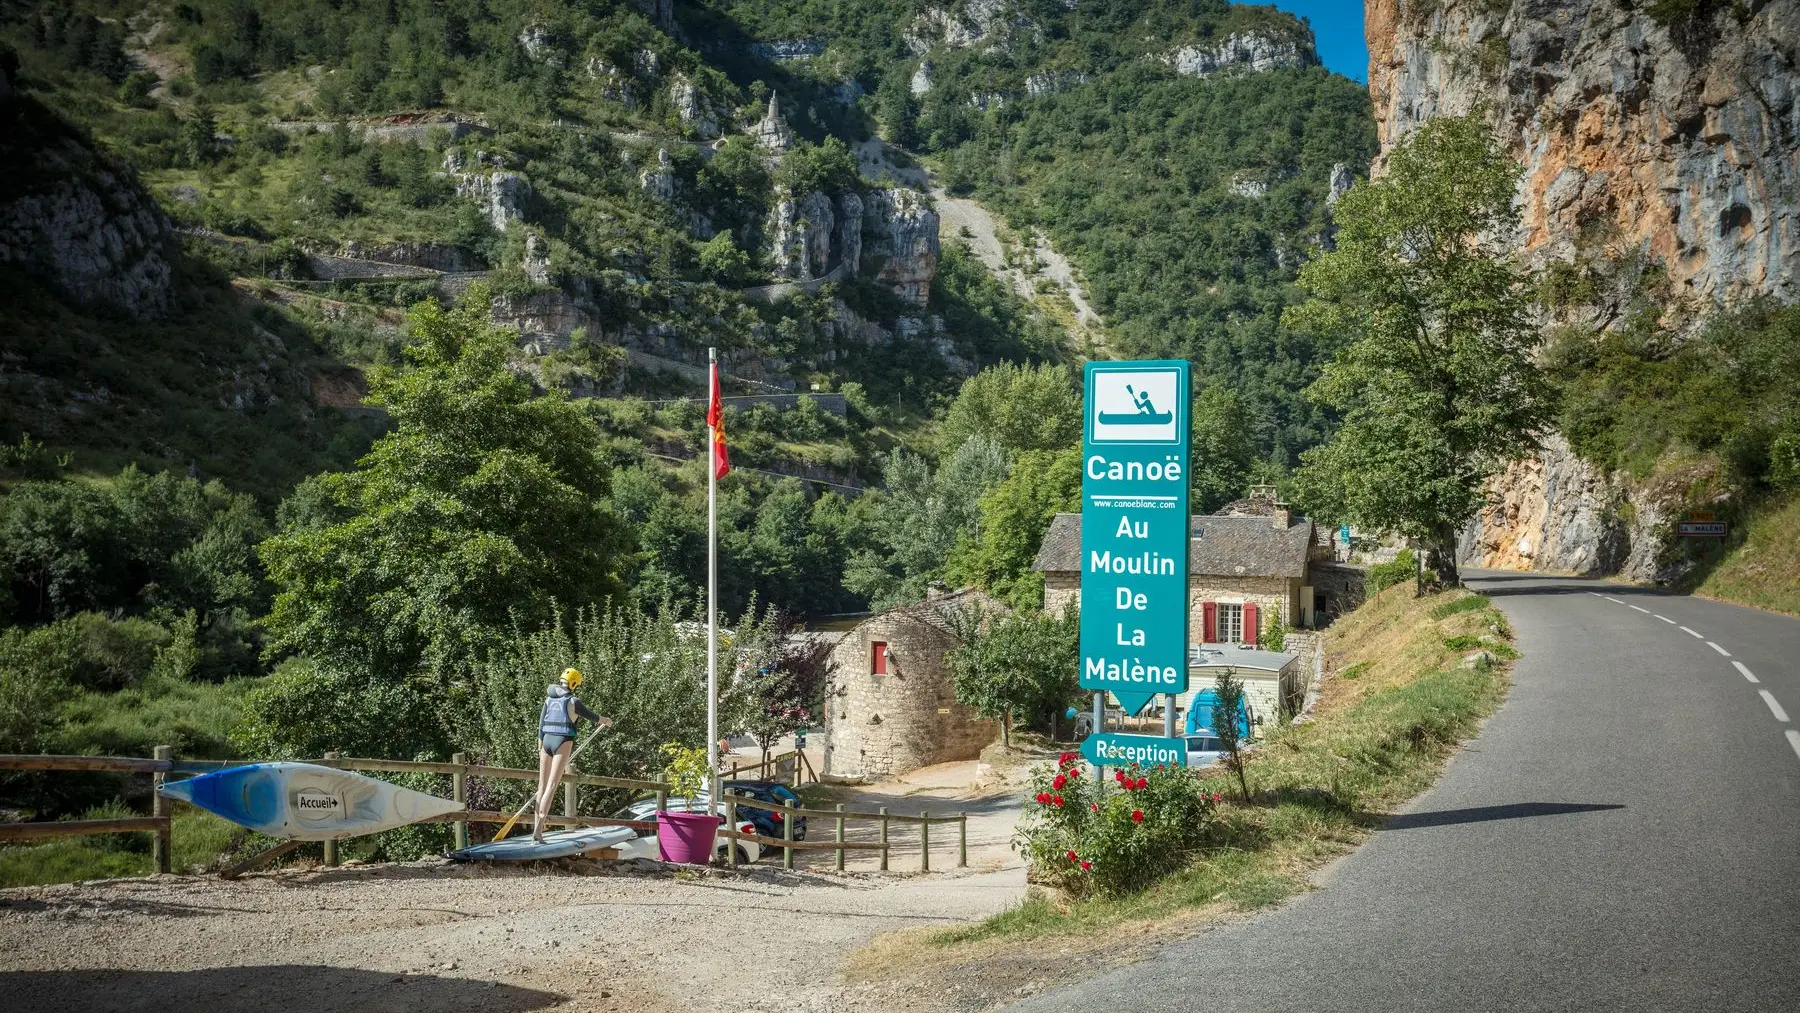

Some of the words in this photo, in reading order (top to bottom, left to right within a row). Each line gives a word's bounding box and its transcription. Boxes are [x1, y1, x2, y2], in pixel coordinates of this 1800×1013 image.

[1087, 455, 1182, 481] Canoë
[1093, 499, 1176, 509] www.canoeblanc.com
[1115, 515, 1149, 539] Au
[1090, 550, 1175, 576] Moulin
[1116, 586, 1148, 611] De
[1117, 622, 1146, 647] La
[1085, 657, 1177, 684] Malène
[1096, 739, 1178, 764] Réception
[300, 796, 332, 809] Accueil
